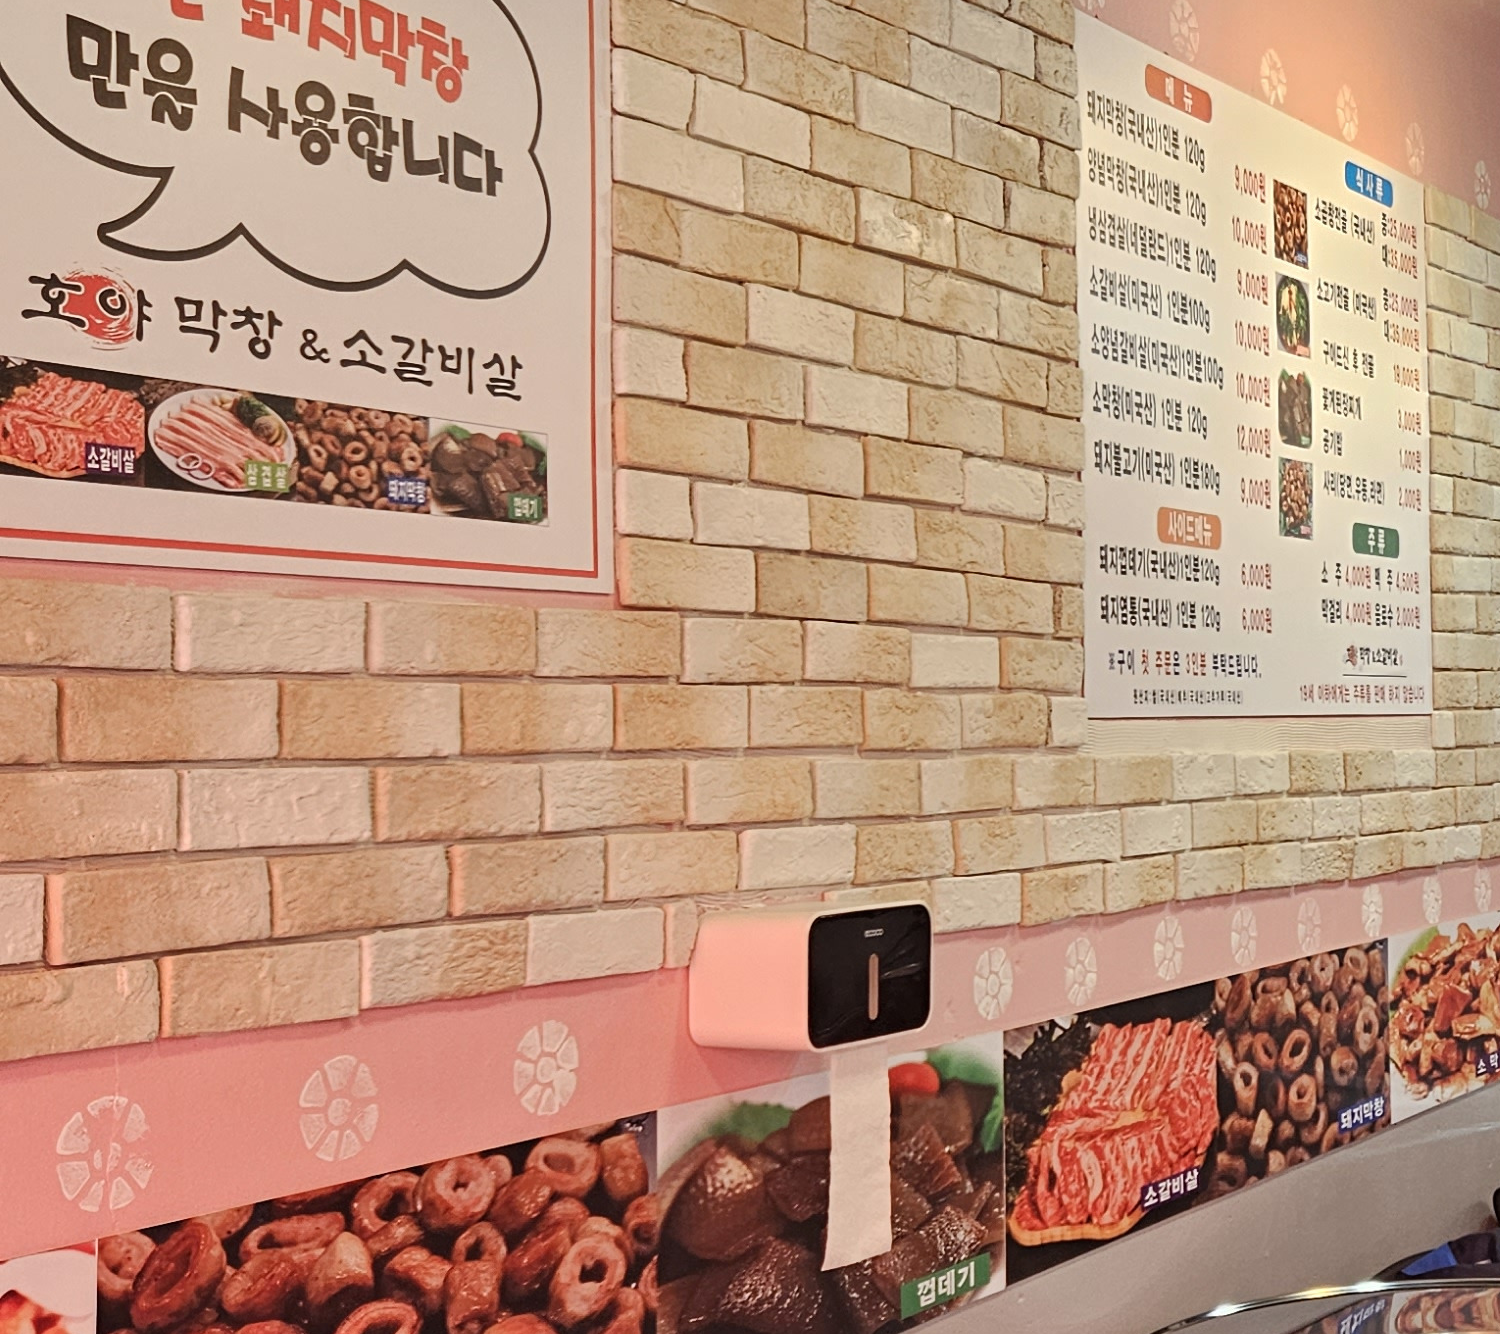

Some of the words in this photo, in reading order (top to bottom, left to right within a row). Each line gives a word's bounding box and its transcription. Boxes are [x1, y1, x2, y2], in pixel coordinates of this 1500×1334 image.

[66, 13, 198, 131] 만을
[227, 66, 503, 197] 사용합니다
[1184, 136, 1206, 174] 120g
[1234, 164, 1267, 204] 9,000원
[1185, 190, 1207, 227] 120g
[1231, 215, 1268, 255] 10,000원
[1195, 246, 1217, 283] 120g
[1237, 268, 1269, 306] 9,000원
[20, 271, 153, 342] 호야
[174, 296, 283, 360] 막창
[299, 328, 331, 364] &
[339, 328, 524, 402] 소갈비살
[1234, 321, 1270, 356] 10,000원
[1235, 372, 1271, 408] 10,000원
[1187, 405, 1208, 440] 120g
[87, 445, 135, 474] 소갈비살
[1239, 477, 1272, 510] 9,000원
[1240, 562, 1273, 590] 6,000원
[1201, 602, 1221, 632] 120g
[1241, 607, 1273, 634] 6,000원
[1339, 1094, 1386, 1134] 돼지막창
[1143, 1167, 1200, 1208] 소갈비살
[915, 1259, 979, 1309] 껍데기
